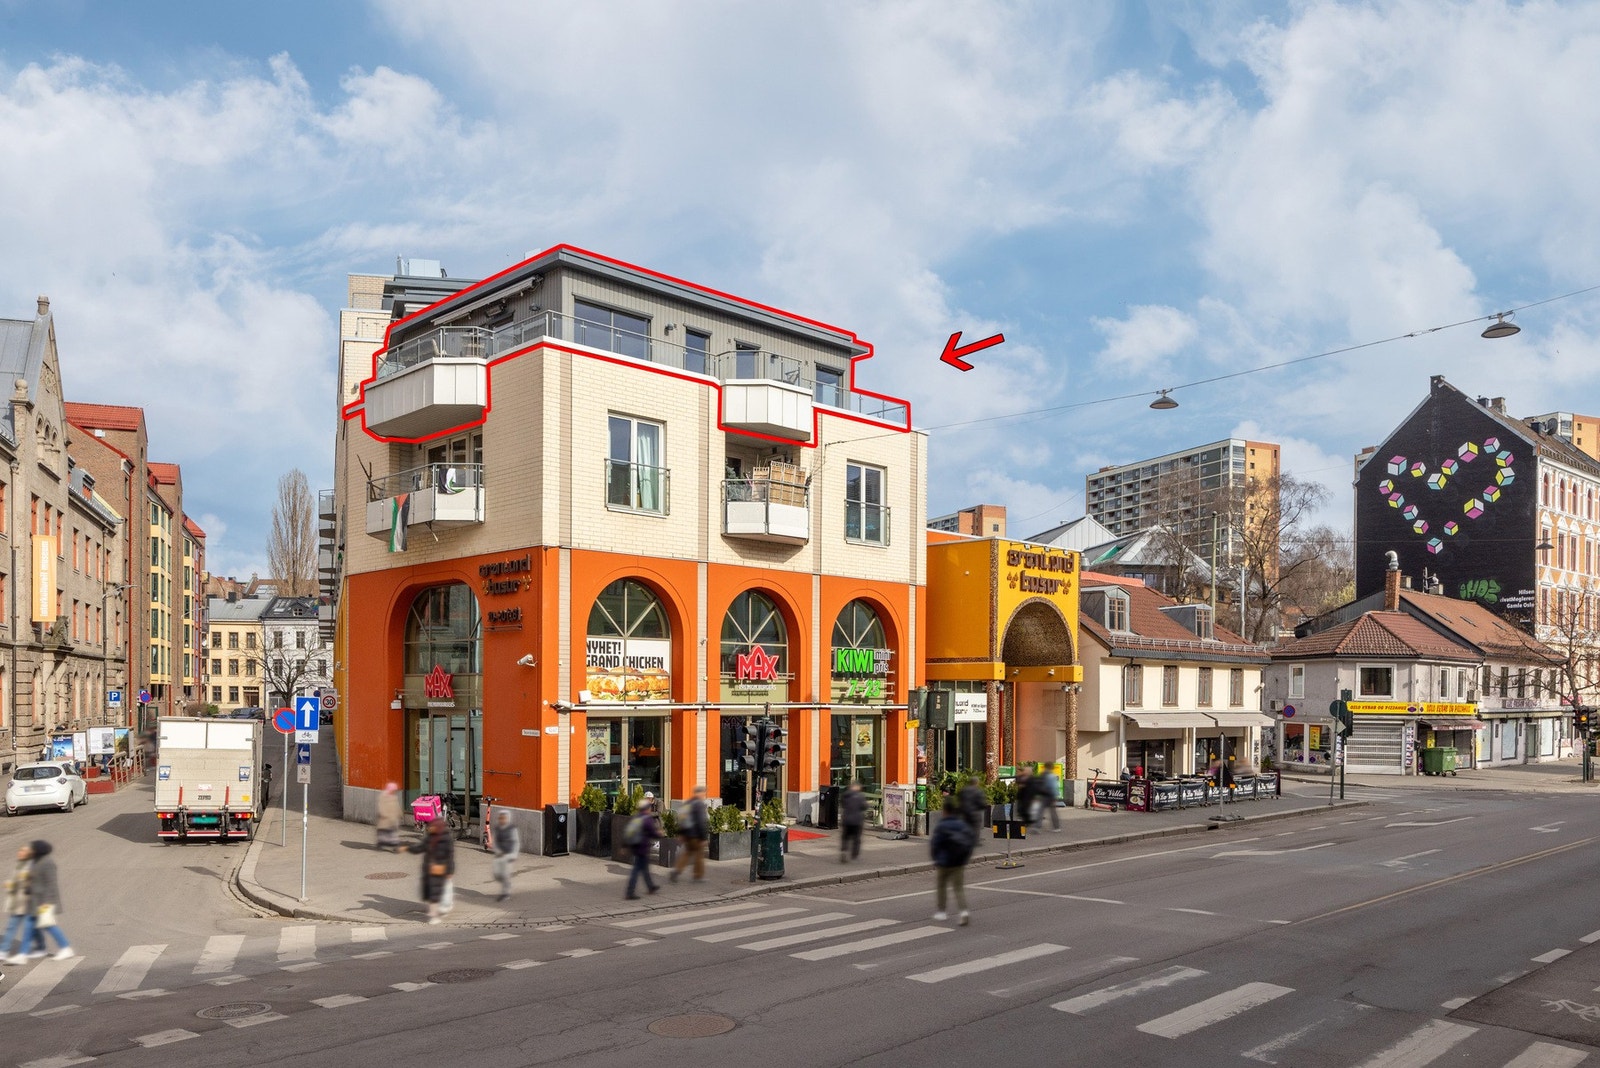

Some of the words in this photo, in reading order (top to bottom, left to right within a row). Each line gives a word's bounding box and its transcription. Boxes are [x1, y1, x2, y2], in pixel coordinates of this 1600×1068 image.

[736, 643, 779, 680] MAX
[836, 648, 874, 673] KIWI
[874, 651, 891, 661] mini
[874, 661, 889, 674] pris
[424, 664, 454, 698] MAX
[111, 692, 118, 700] P
[325, 698, 333, 706] 30
